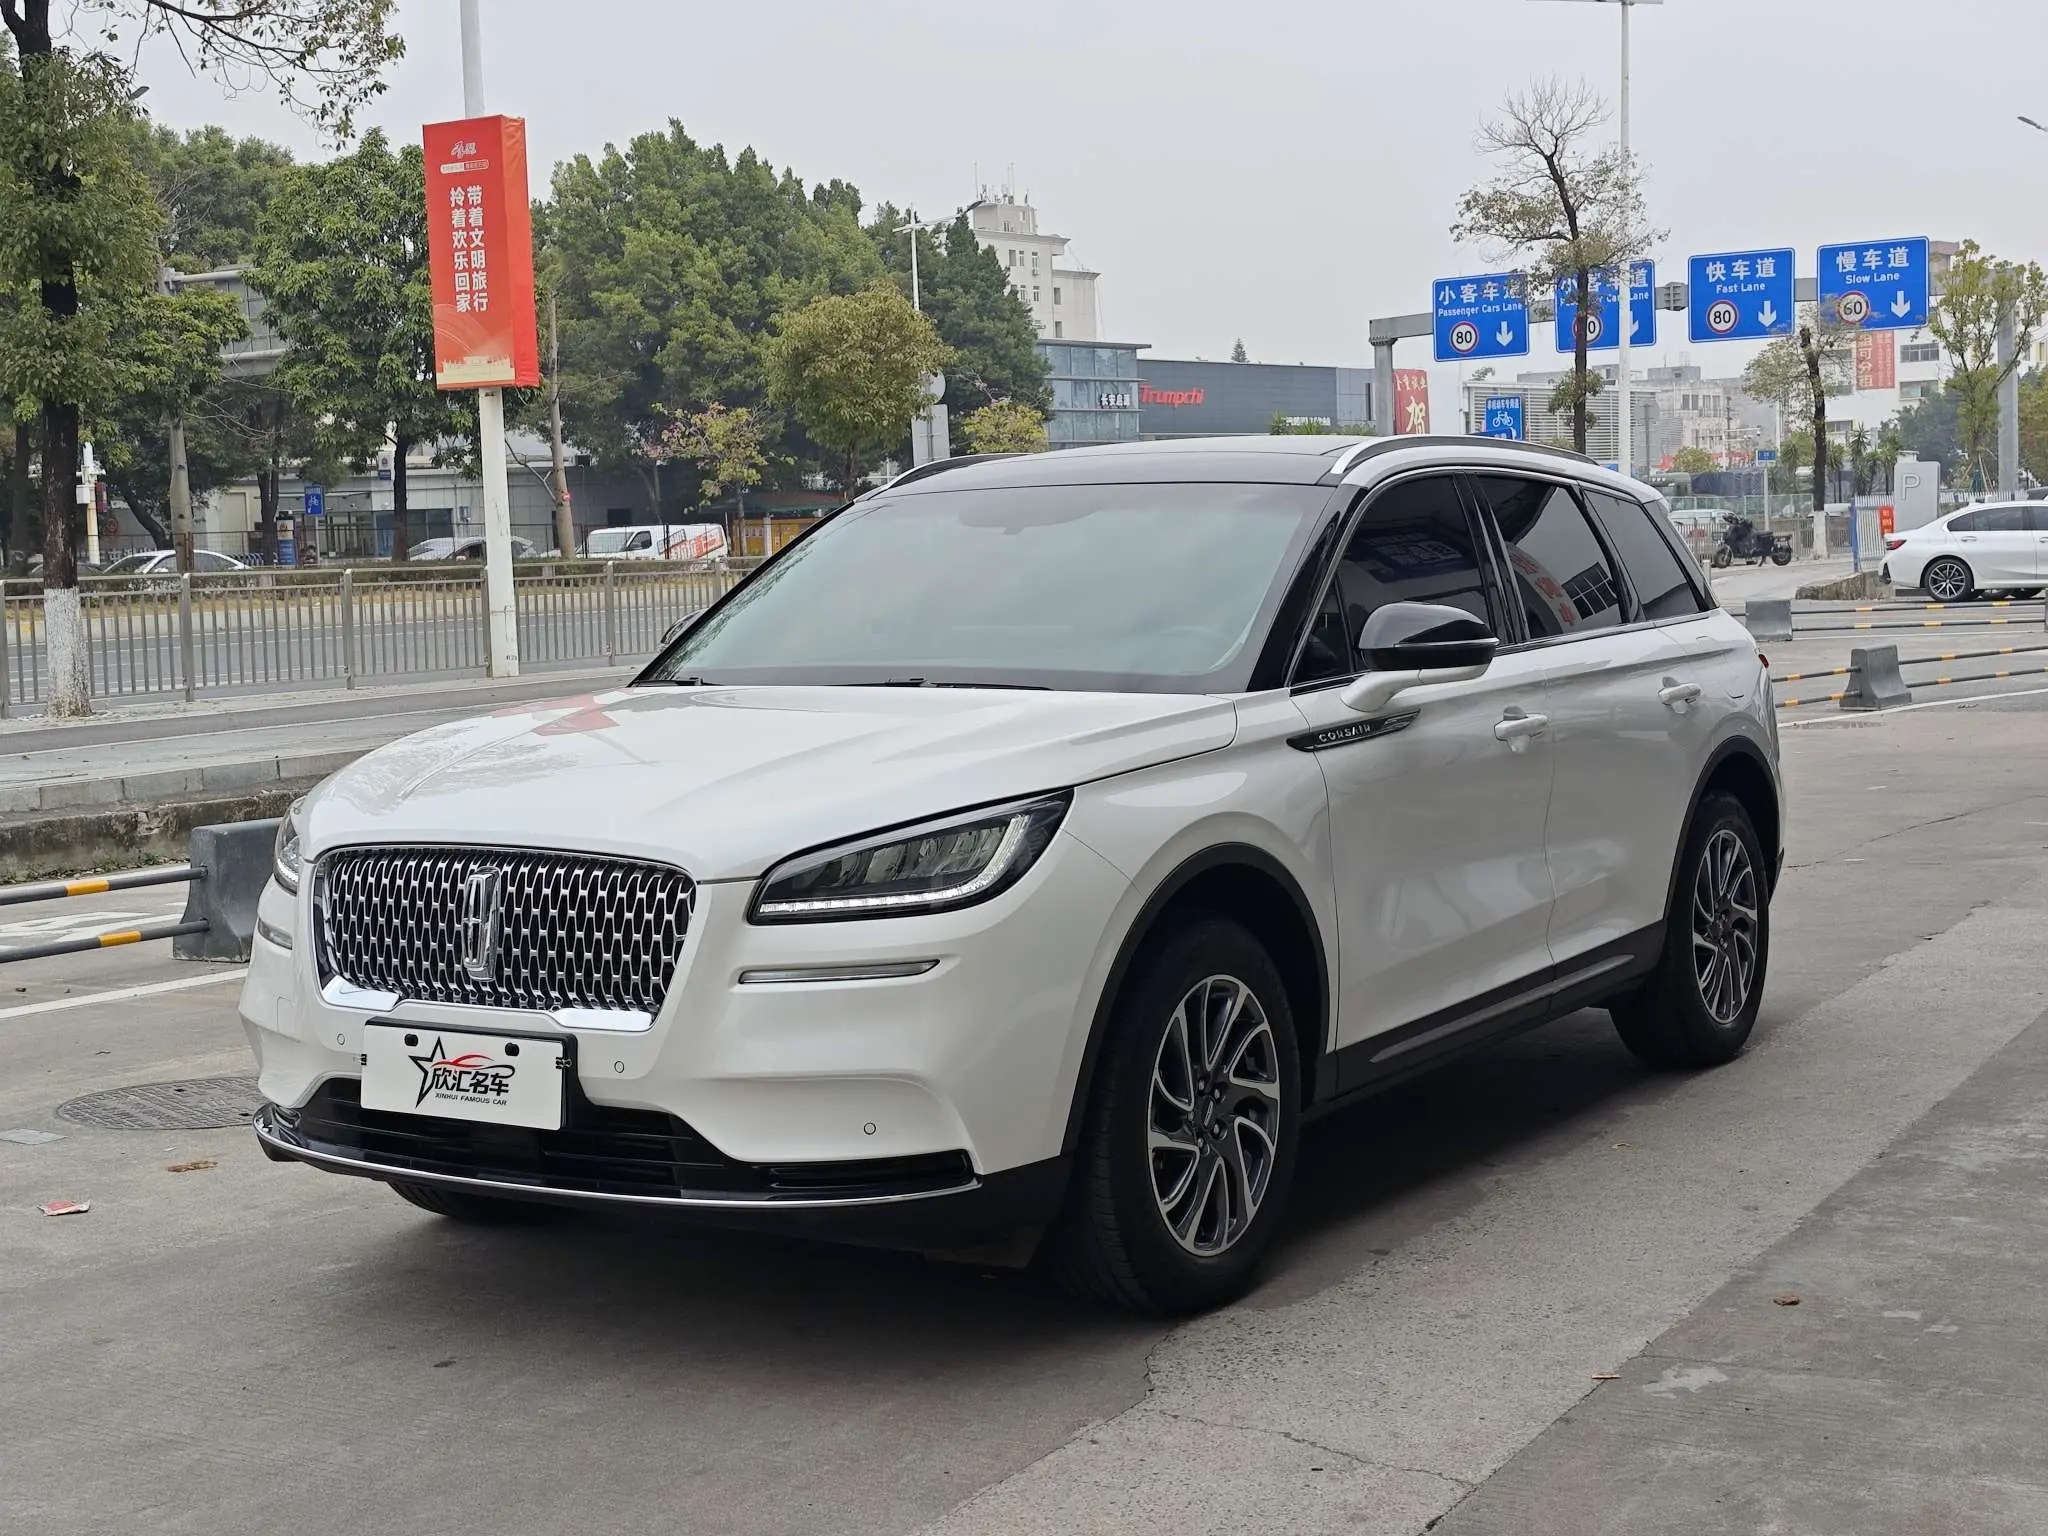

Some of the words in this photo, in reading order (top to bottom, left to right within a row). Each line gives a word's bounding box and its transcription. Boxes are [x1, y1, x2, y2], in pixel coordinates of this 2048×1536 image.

[450, 186, 471, 312] 拎着欢乐回家
[467, 185, 488, 312] 带着文明旅行
[1836, 246, 1909, 272] 慢车道
[1706, 257, 1776, 282] 快车道
[1846, 275, 1870, 284] Slow
[1874, 272, 1900, 281] Lane
[1439, 281, 1522, 305] 小客车道
[1716, 284, 1737, 294] Fast
[1741, 282, 1765, 292] Lane
[1438, 306, 1479, 317] Passenger
[1482, 304, 1500, 312] Cars
[1503, 301, 1522, 310] Lane
[1713, 310, 1731, 324] 80
[1843, 301, 1862, 315] 60
[1456, 331, 1472, 344] 80
[1140, 383, 1204, 408] Trumpchi
[1901, 473, 1920, 500] P
[433, 1067, 510, 1097] 欣汇名车
[435, 1092, 459, 1101] XINHUI
[461, 1094, 490, 1104] FAMOUS
[492, 1098, 508, 1106] CAR
